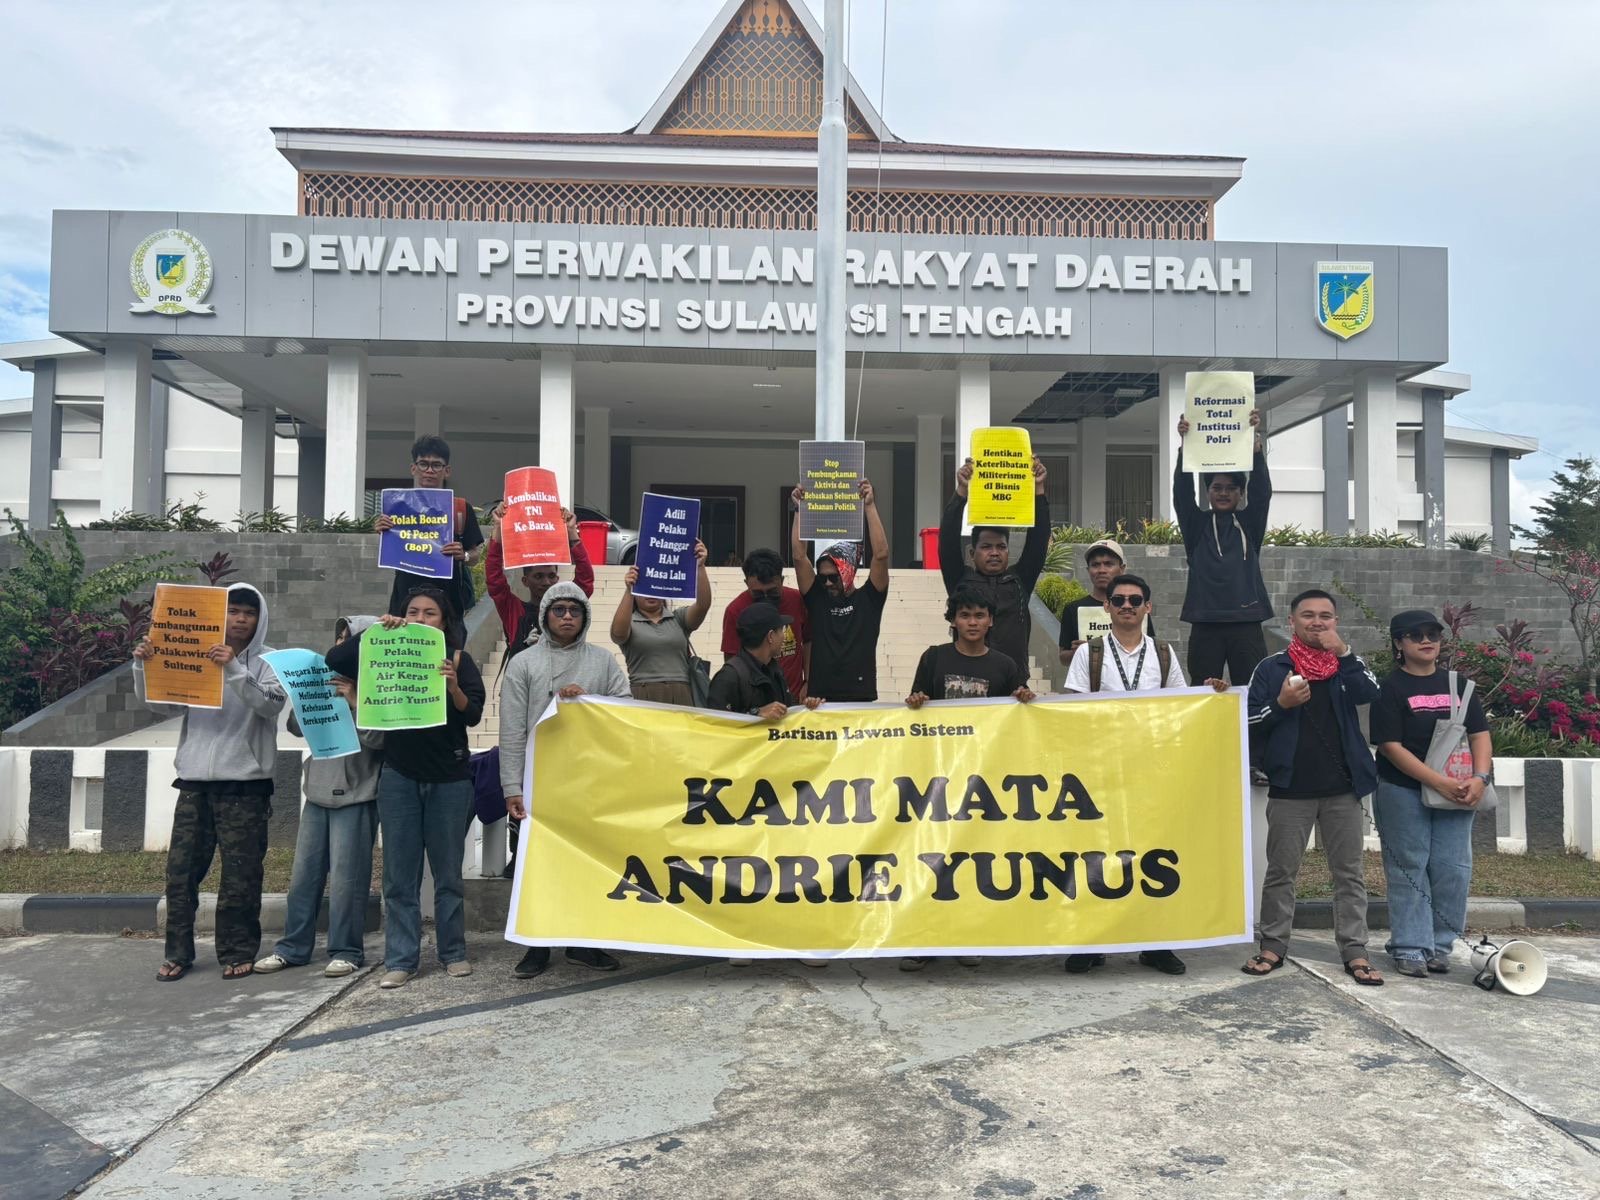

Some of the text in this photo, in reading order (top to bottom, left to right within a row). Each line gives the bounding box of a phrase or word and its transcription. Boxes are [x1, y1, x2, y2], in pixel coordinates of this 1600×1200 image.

[271, 232, 1252, 292] DEWAN PERWAKILAN RAKYAT DAERAH
[457, 293, 1072, 337] PROVINSI SULAWSI TENGAH
[1194, 396, 1246, 406] Reformasi
[1206, 410, 1232, 418] Total
[1197, 422, 1241, 431] Institusi
[1206, 435, 1231, 444] Polri
[983, 449, 1023, 458] Hentikan
[824, 459, 840, 469] Stop
[976, 460, 1029, 469] Keterlibatan
[807, 470, 857, 480] Pembungkaman
[978, 471, 1027, 480] Militerisme
[814, 481, 850, 489] Aktivis dan
[995, 483, 1020, 491] Bisnis
[508, 491, 557, 505] Kembalikan
[804, 492, 860, 500] Bebaskan Seluruh
[525, 506, 543, 516] TNI
[808, 503, 856, 511] Tahanan Politik
[391, 514, 448, 525] Tolak Board
[664, 508, 686, 520] Adili
[514, 521, 555, 532] Ke Barak
[658, 523, 687, 535] Pelaku
[399, 530, 439, 540] Of Peace
[405, 542, 433, 554] (BoP)
[649, 537, 690, 552] Pelanggar
[658, 554, 680, 565] HAM
[645, 567, 686, 580] Masa Lalu
[167, 607, 197, 618] Tolak
[164, 634, 200, 645] Kodam
[370, 637, 436, 646] Usut Tuntas
[384, 648, 422, 657] Pelaku
[164, 660, 203, 673] Sulteng
[370, 660, 435, 670] Penyiraman
[283, 666, 331, 678] Negara Haru
[376, 671, 429, 681] Air Keras
[288, 679, 320, 689] Menjamin
[376, 684, 429, 694] Terhadap
[299, 689, 332, 700] Melindungi
[363, 695, 440, 706] Andrie Yunus
[302, 703, 334, 714] Kebebasan
[303, 713, 340, 726] Berekspresi
[768, 723, 974, 741] Barisan Lawan Sistem
[682, 773, 1104, 825] KAMI MATA
[607, 848, 1180, 904] ANDRIE YUNUS
